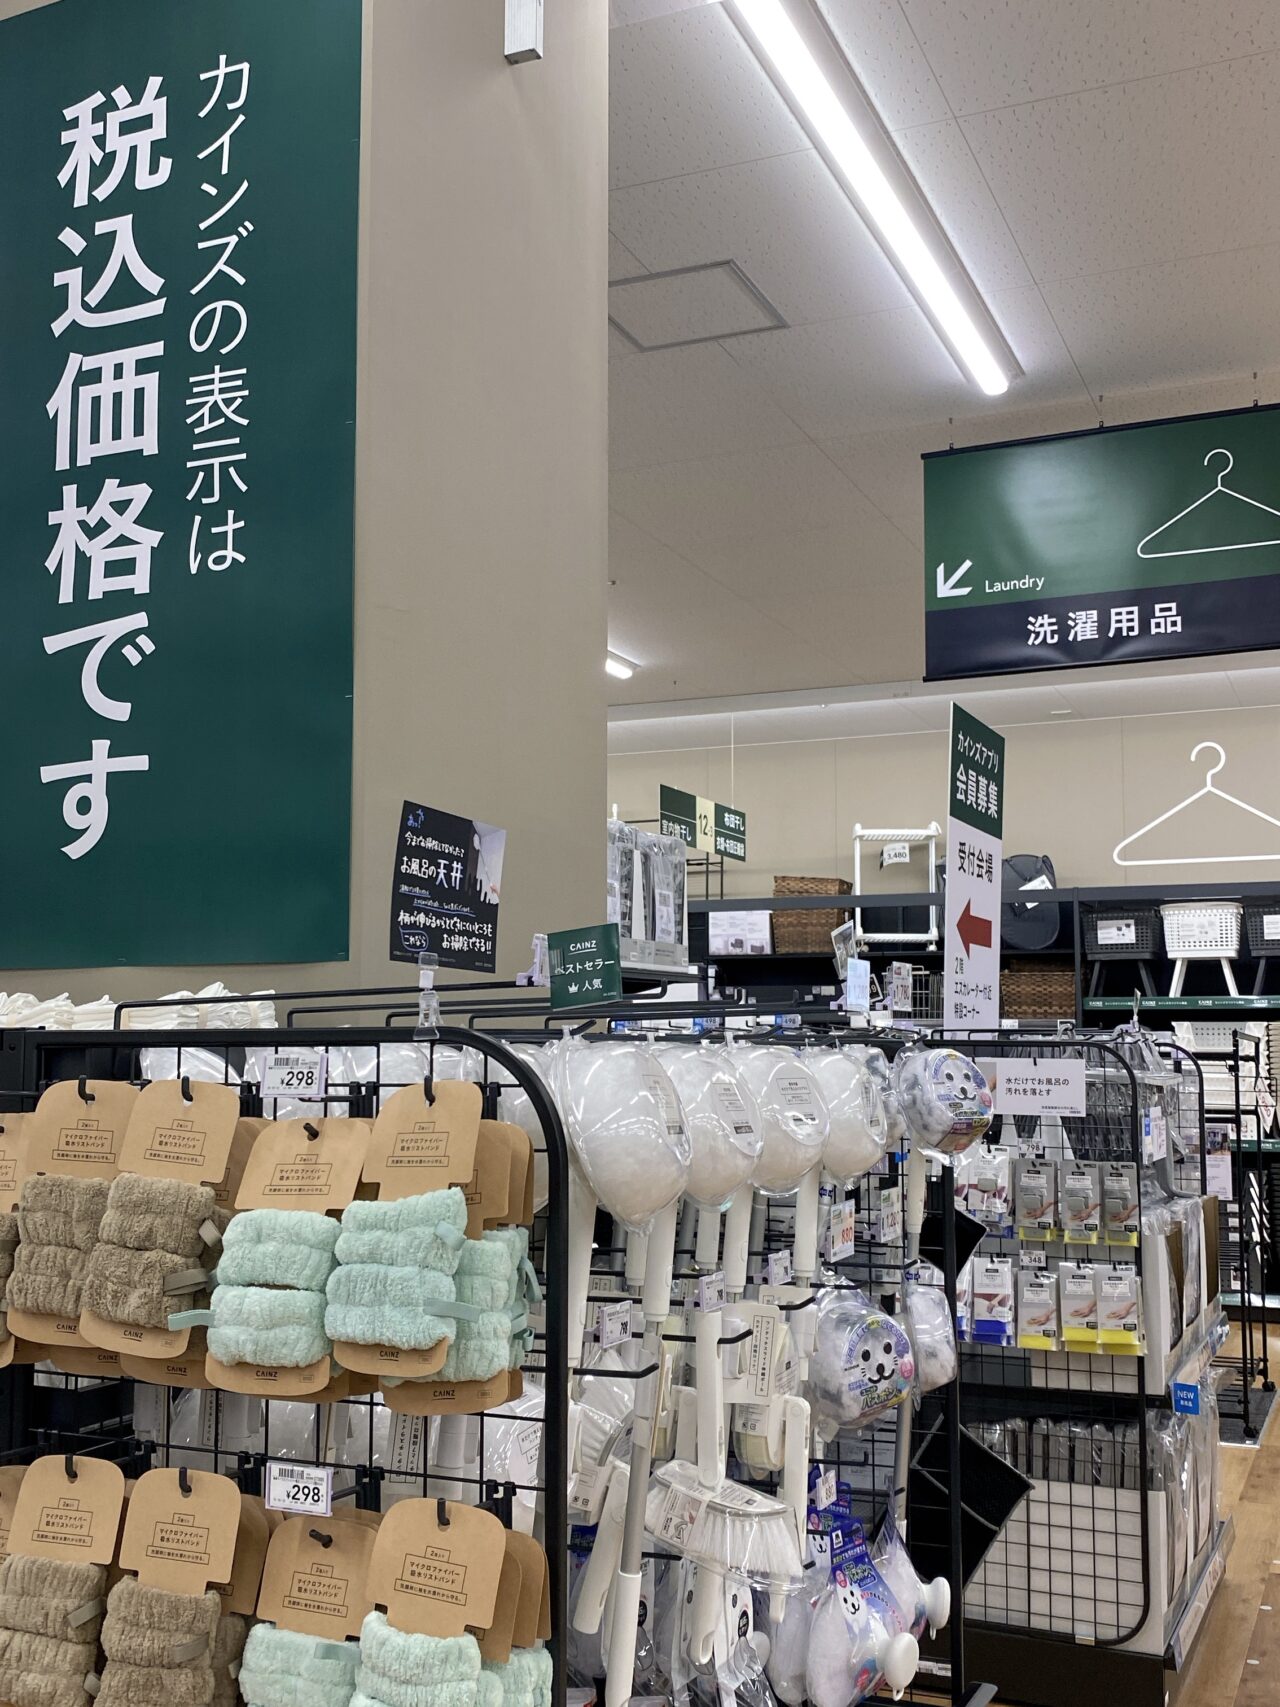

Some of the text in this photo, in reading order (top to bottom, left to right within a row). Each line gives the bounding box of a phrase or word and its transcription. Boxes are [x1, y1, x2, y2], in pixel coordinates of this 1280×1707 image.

[185, 54, 253, 575] カインズの表示は
[39, 75, 172, 861] 税込価格です
[985, 574, 1045, 593] Laundry
[1026, 602, 1182, 646] 洗濯用品
[957, 730, 999, 774] カインズアプリ
[956, 763, 998, 819] 会員募集
[724, 812, 745, 831] 布団干し
[958, 841, 993, 884] 受付会場
[569, 940, 597, 951] CAINZ
[554, 958, 615, 975] ベストセラー
[582, 978, 603, 992] 人気
[280, 1070, 314, 1087] ¥298
[1005, 1077, 1070, 1086] 水だけでお風呂の
[1005, 1088, 1053, 1096] 汚れを落とす
[1026, 1143, 1041, 1152] 798
[1027, 1256, 1042, 1265] 348
[56, 1323, 77, 1331] CAINZ
[123, 1329, 143, 1338] CAINZ
[380, 1350, 400, 1358] CAINZ
[166, 1365, 187, 1373] CAINZ
[256, 1370, 278, 1378] CAINZ
[433, 1389, 455, 1397] CAINZ
[1177, 1390, 1195, 1400] NEW
[286, 1484, 321, 1503] ¥298
[409, 1561, 461, 1576] マイクロファイバー
